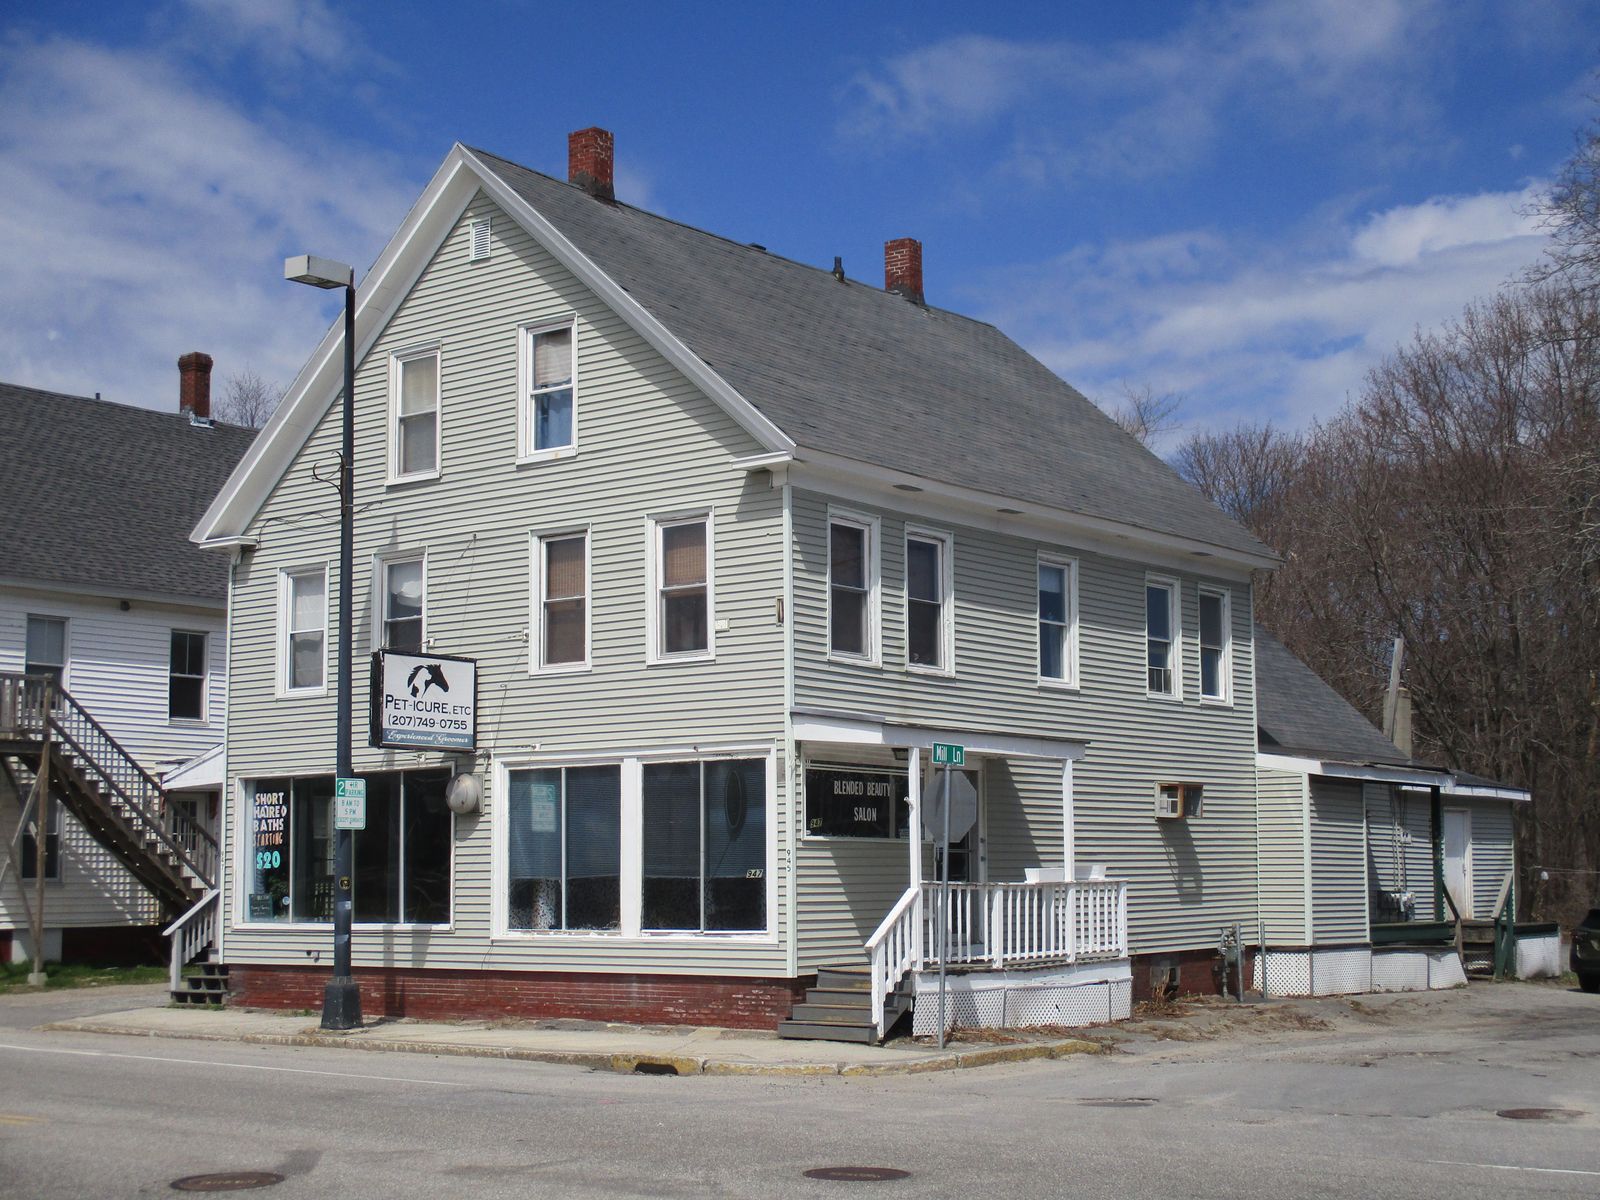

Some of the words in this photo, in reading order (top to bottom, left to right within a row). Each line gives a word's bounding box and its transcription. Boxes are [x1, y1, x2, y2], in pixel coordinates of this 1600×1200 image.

[452, 705, 471, 715] ETC
[388, 713, 467, 730] (207)749-0755
[936, 745, 948, 761] Mill
[952, 746, 961, 763] Ln
[338, 780, 345, 796] 2
[834, 780, 864, 795] BLENDED
[867, 782, 890, 797] BEAUTY
[255, 792, 284, 805] SHORT
[253, 805, 287, 818] HAIRED
[854, 807, 877, 822] SALON
[253, 818, 284, 832] BATHS
[256, 850, 280, 869] $20
